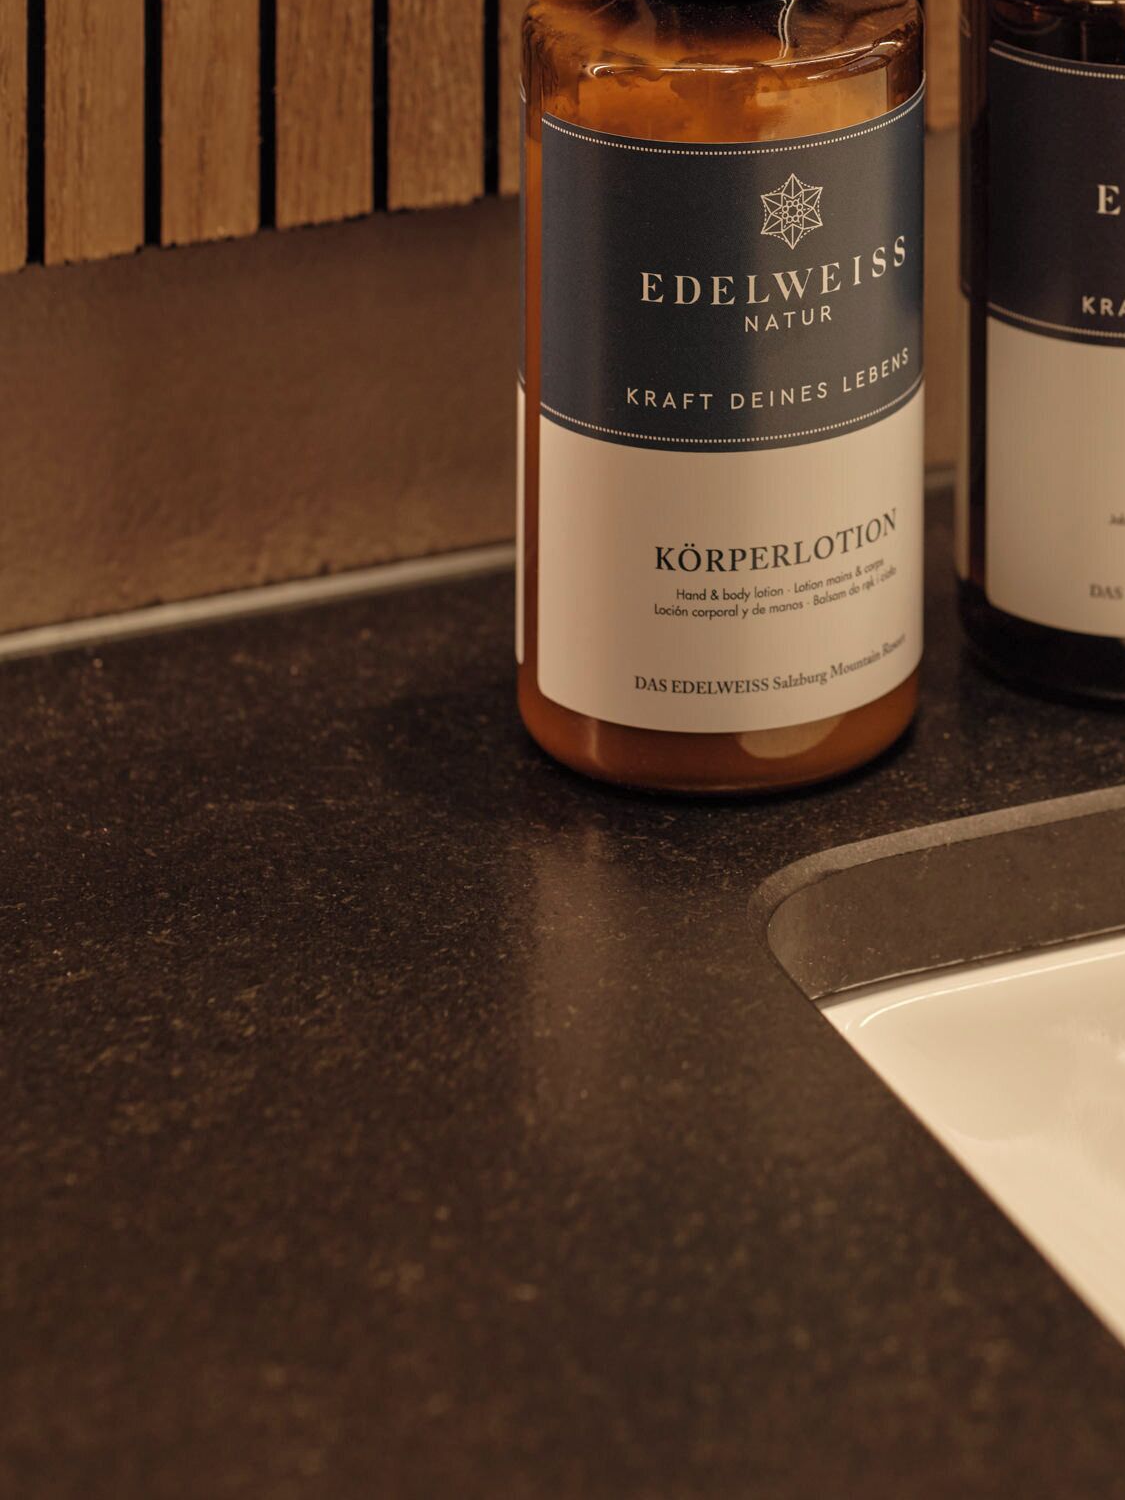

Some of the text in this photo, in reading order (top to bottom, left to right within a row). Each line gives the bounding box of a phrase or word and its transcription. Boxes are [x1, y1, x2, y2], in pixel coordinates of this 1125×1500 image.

[640, 235, 907, 306] EDELWEISS
[744, 304, 832, 333] NATUR
[627, 347, 910, 411] KRAFT DEINES LEBENS
[655, 508, 898, 572] KÖRPERLOTION
[654, 603, 689, 616] Loción
[691, 604, 739, 620] corporal
[741, 608, 749, 619] y
[752, 603, 766, 615] de
[768, 600, 804, 613] manos
[813, 590, 847, 606] Balsam
[849, 582, 860, 596] do
[676, 588, 707, 601] Hand
[710, 589, 720, 601] &
[722, 587, 751, 602] body
[754, 586, 784, 599] lotion
[794, 580, 823, 594] Lotion
[826, 571, 853, 586] mains
[1090, 583, 1123, 600] DAS
[634, 675, 667, 693] DAS
[672, 678, 769, 695] EDELWEISS
[773, 672, 828, 690] Salzburg
[830, 650, 881, 679] Mountain
